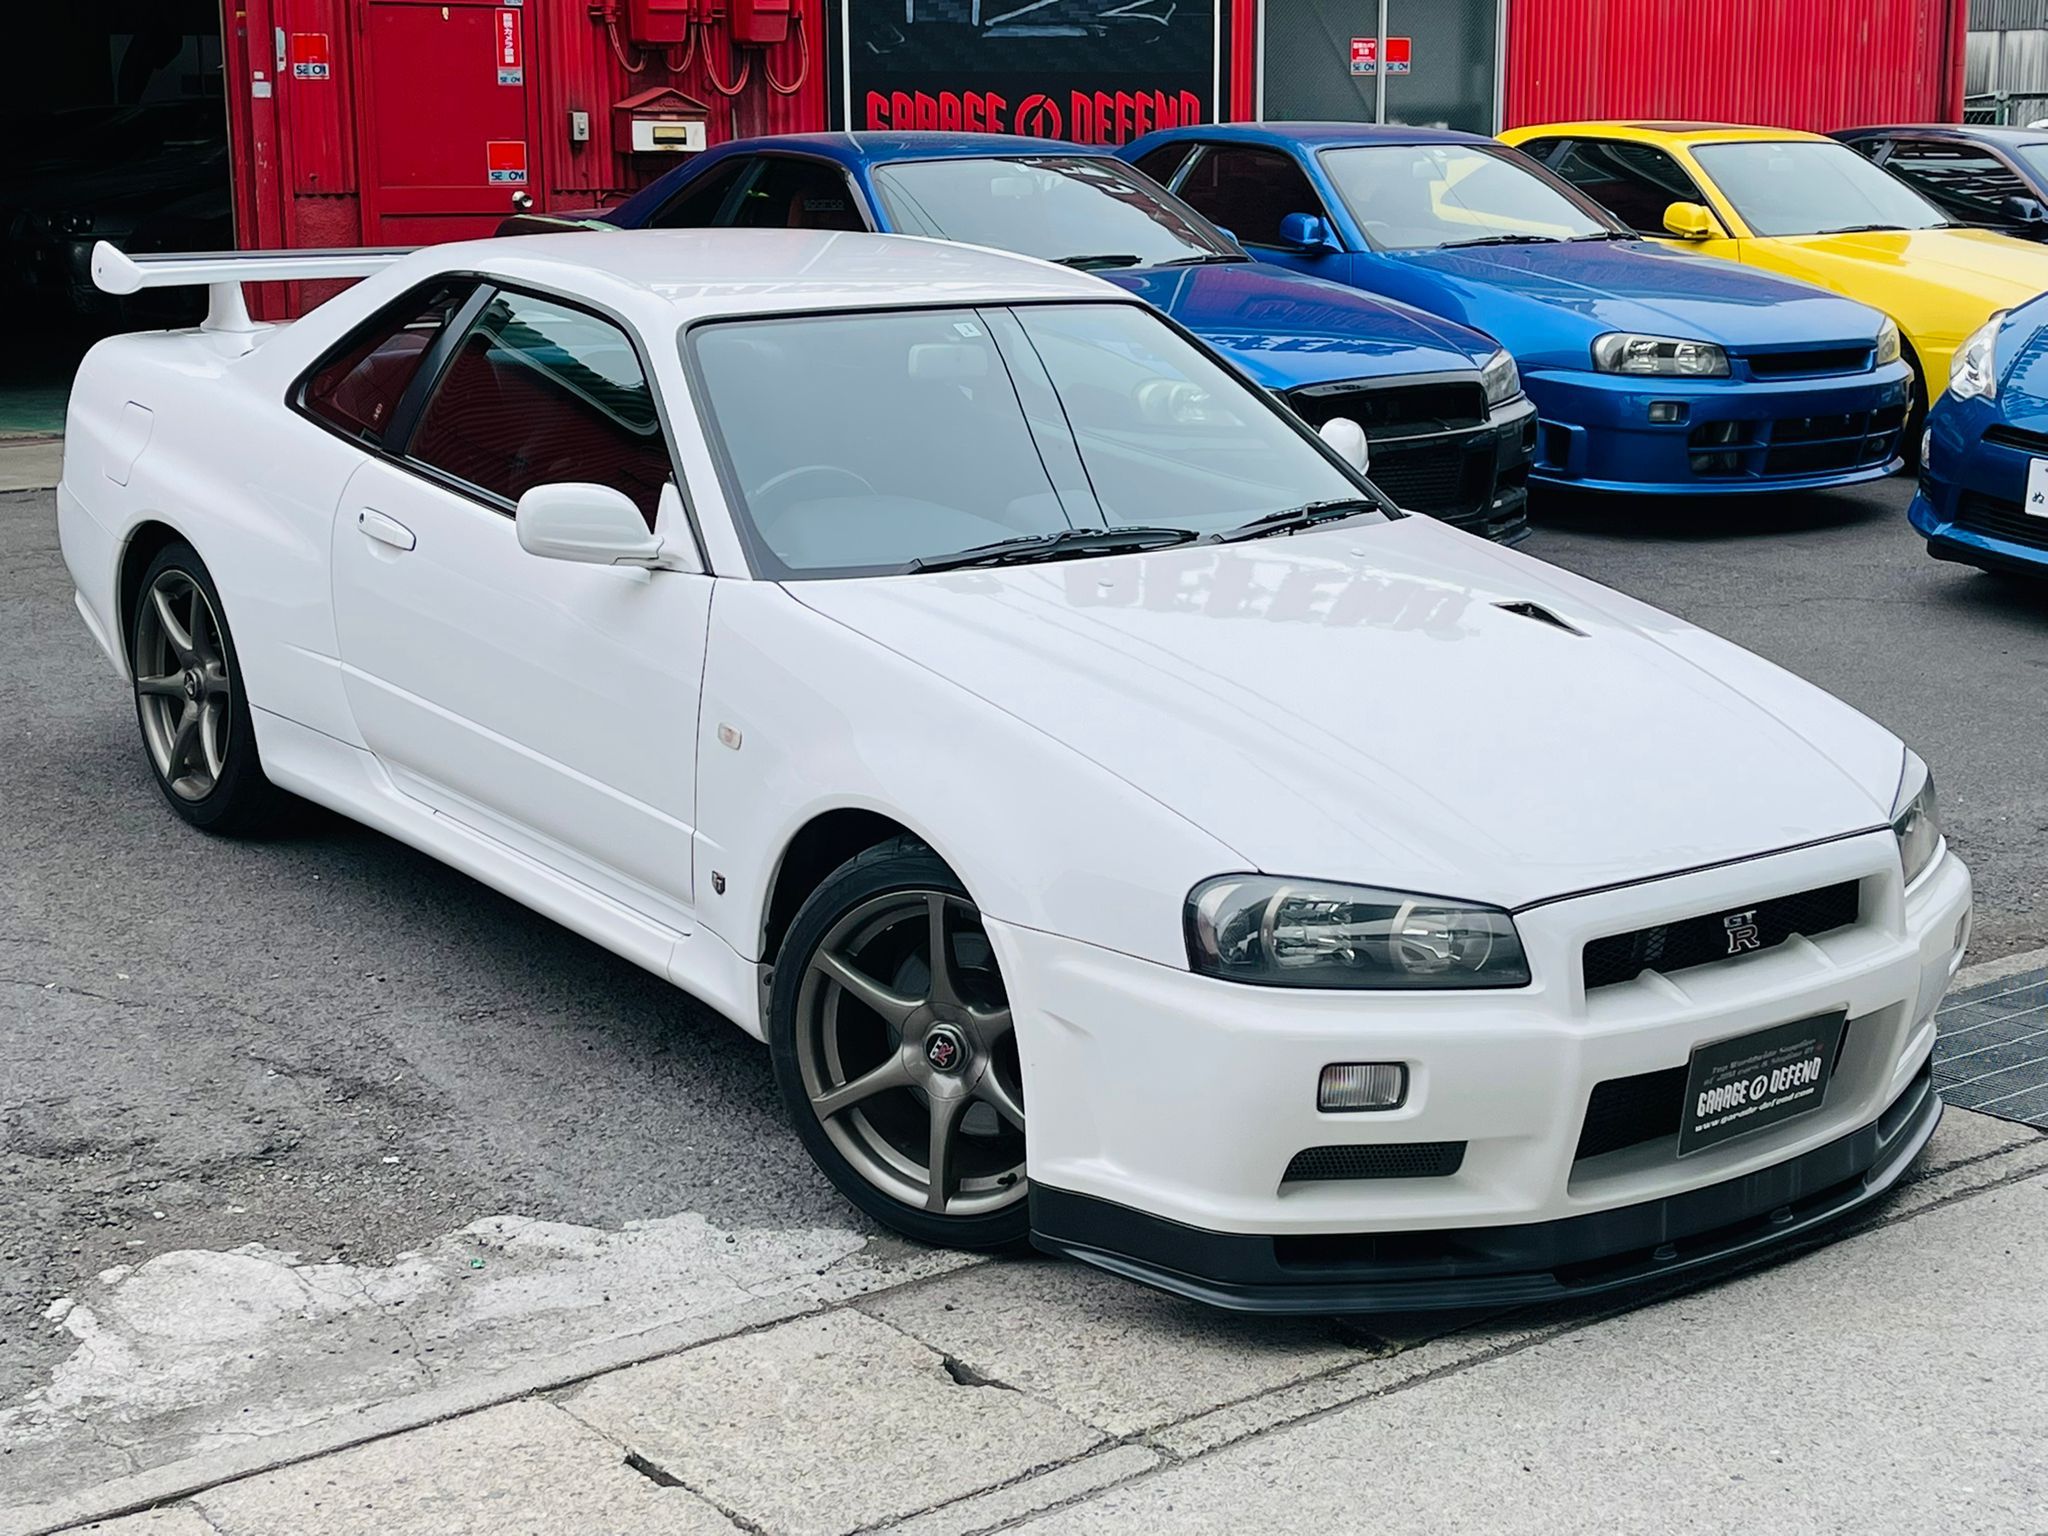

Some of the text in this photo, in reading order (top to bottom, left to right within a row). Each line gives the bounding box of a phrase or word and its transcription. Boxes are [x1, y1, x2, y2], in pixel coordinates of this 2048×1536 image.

[866, 90, 1200, 145] GARAGE DEFEND
[1724, 910, 1757, 928] GT
[1727, 924, 1760, 953] R
[1696, 1057, 1822, 1117] GARAGE DEFEND
